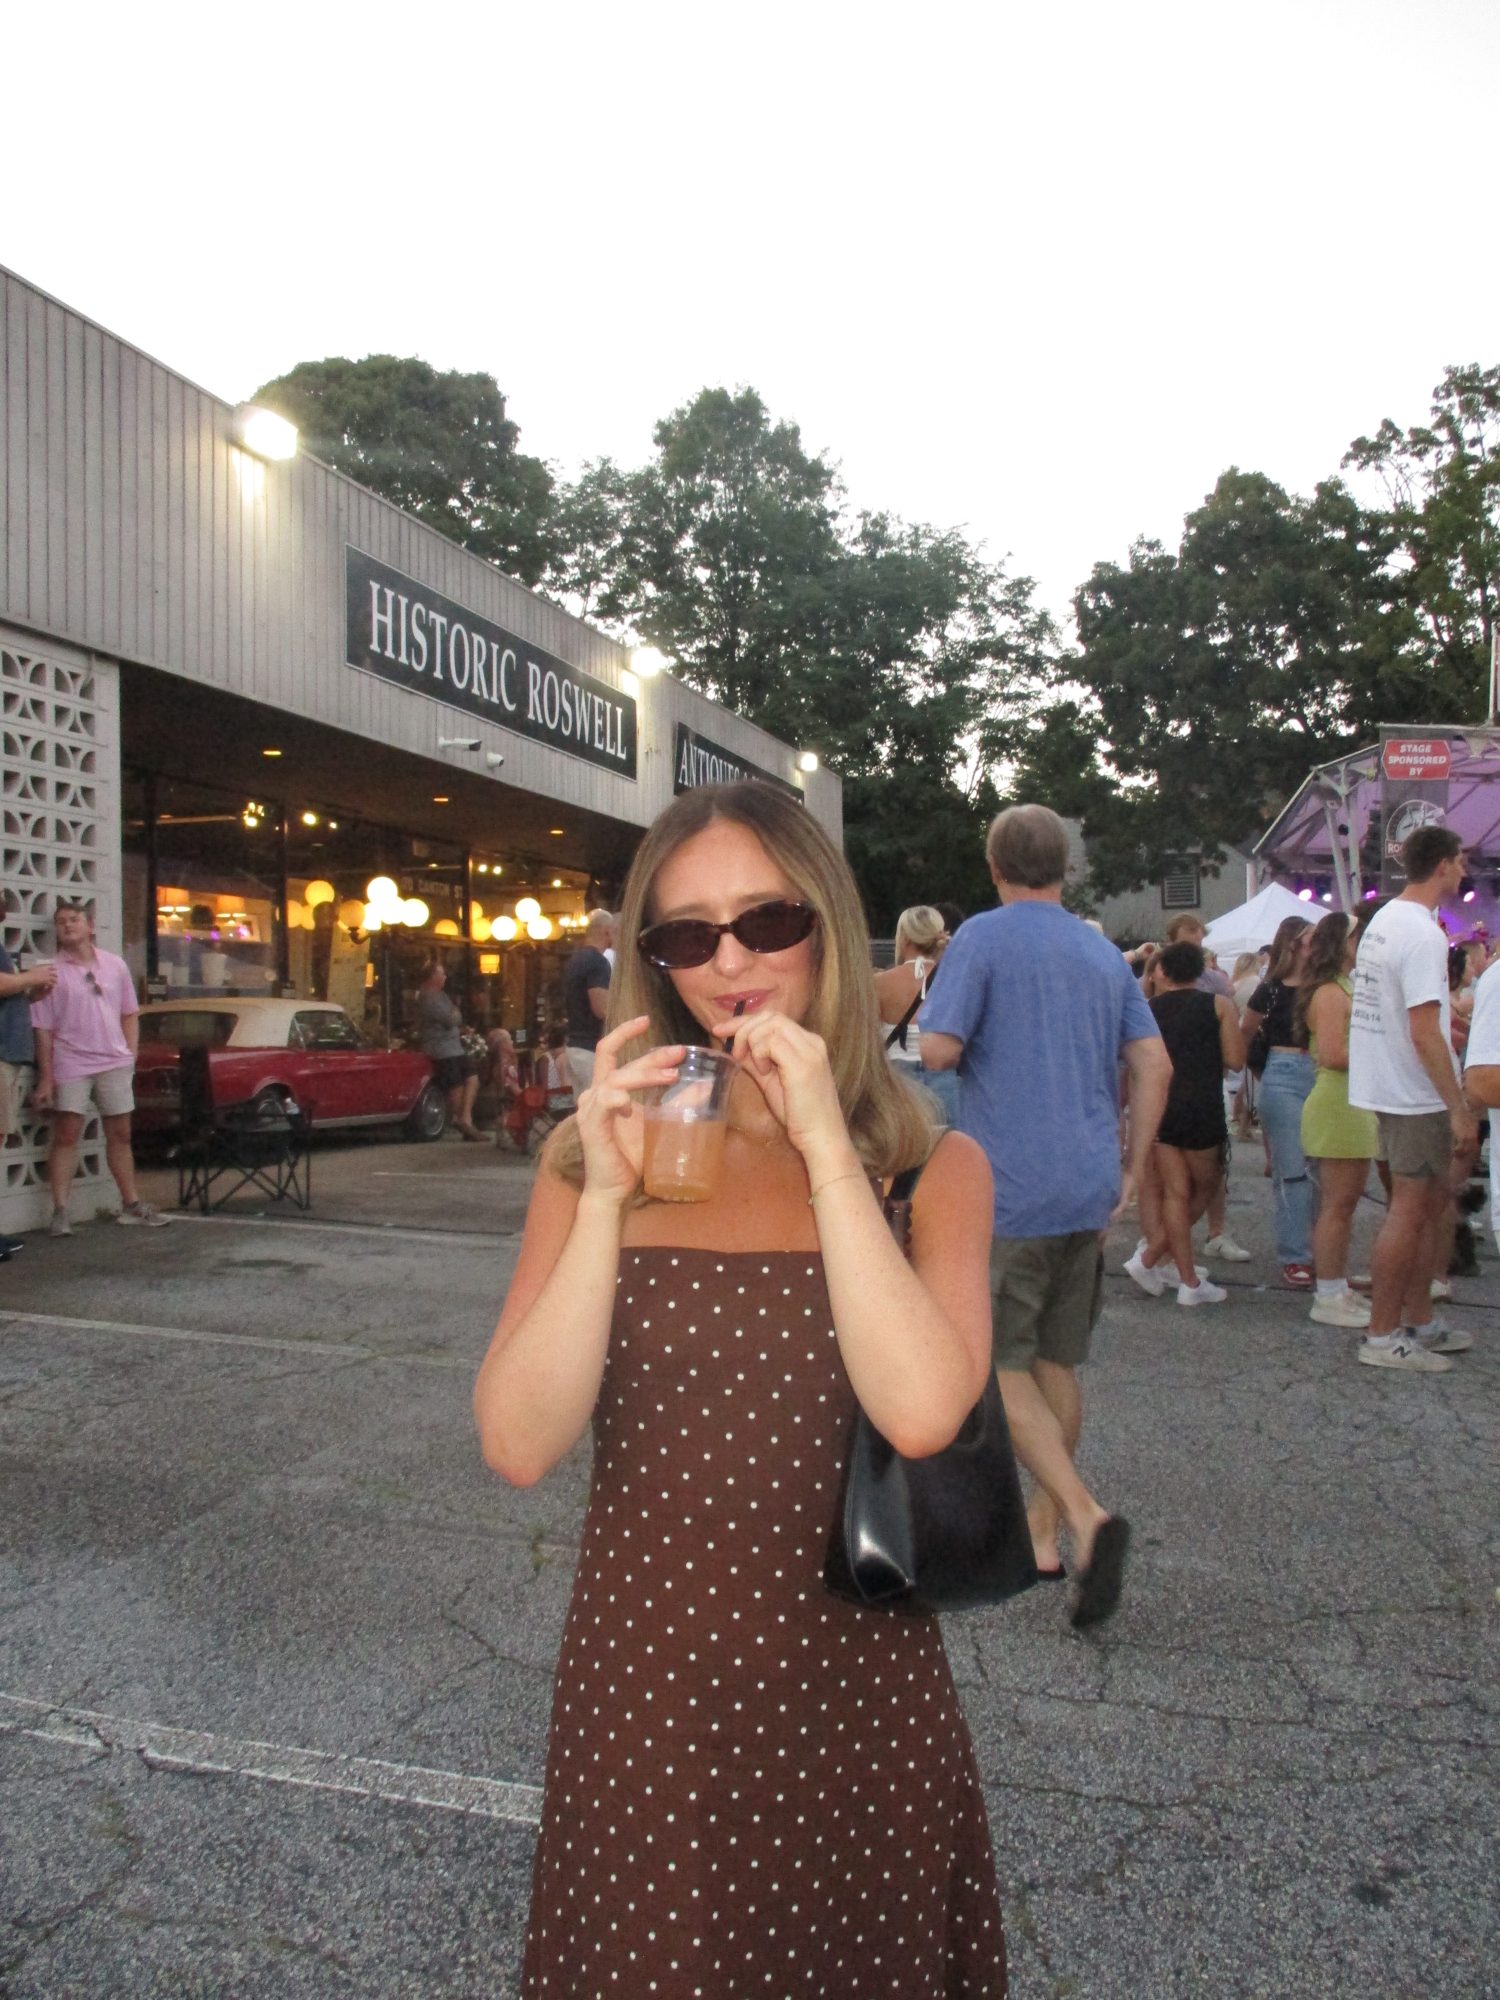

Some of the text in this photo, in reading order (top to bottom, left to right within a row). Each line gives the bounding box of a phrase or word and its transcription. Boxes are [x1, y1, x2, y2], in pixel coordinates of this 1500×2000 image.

[369, 579, 627, 761] HISTORIC ROSWELL
[1400, 744, 1432, 753] STAGE
[1388, 755, 1447, 765] SPONSORED
[1409, 767, 1423, 776] BY
